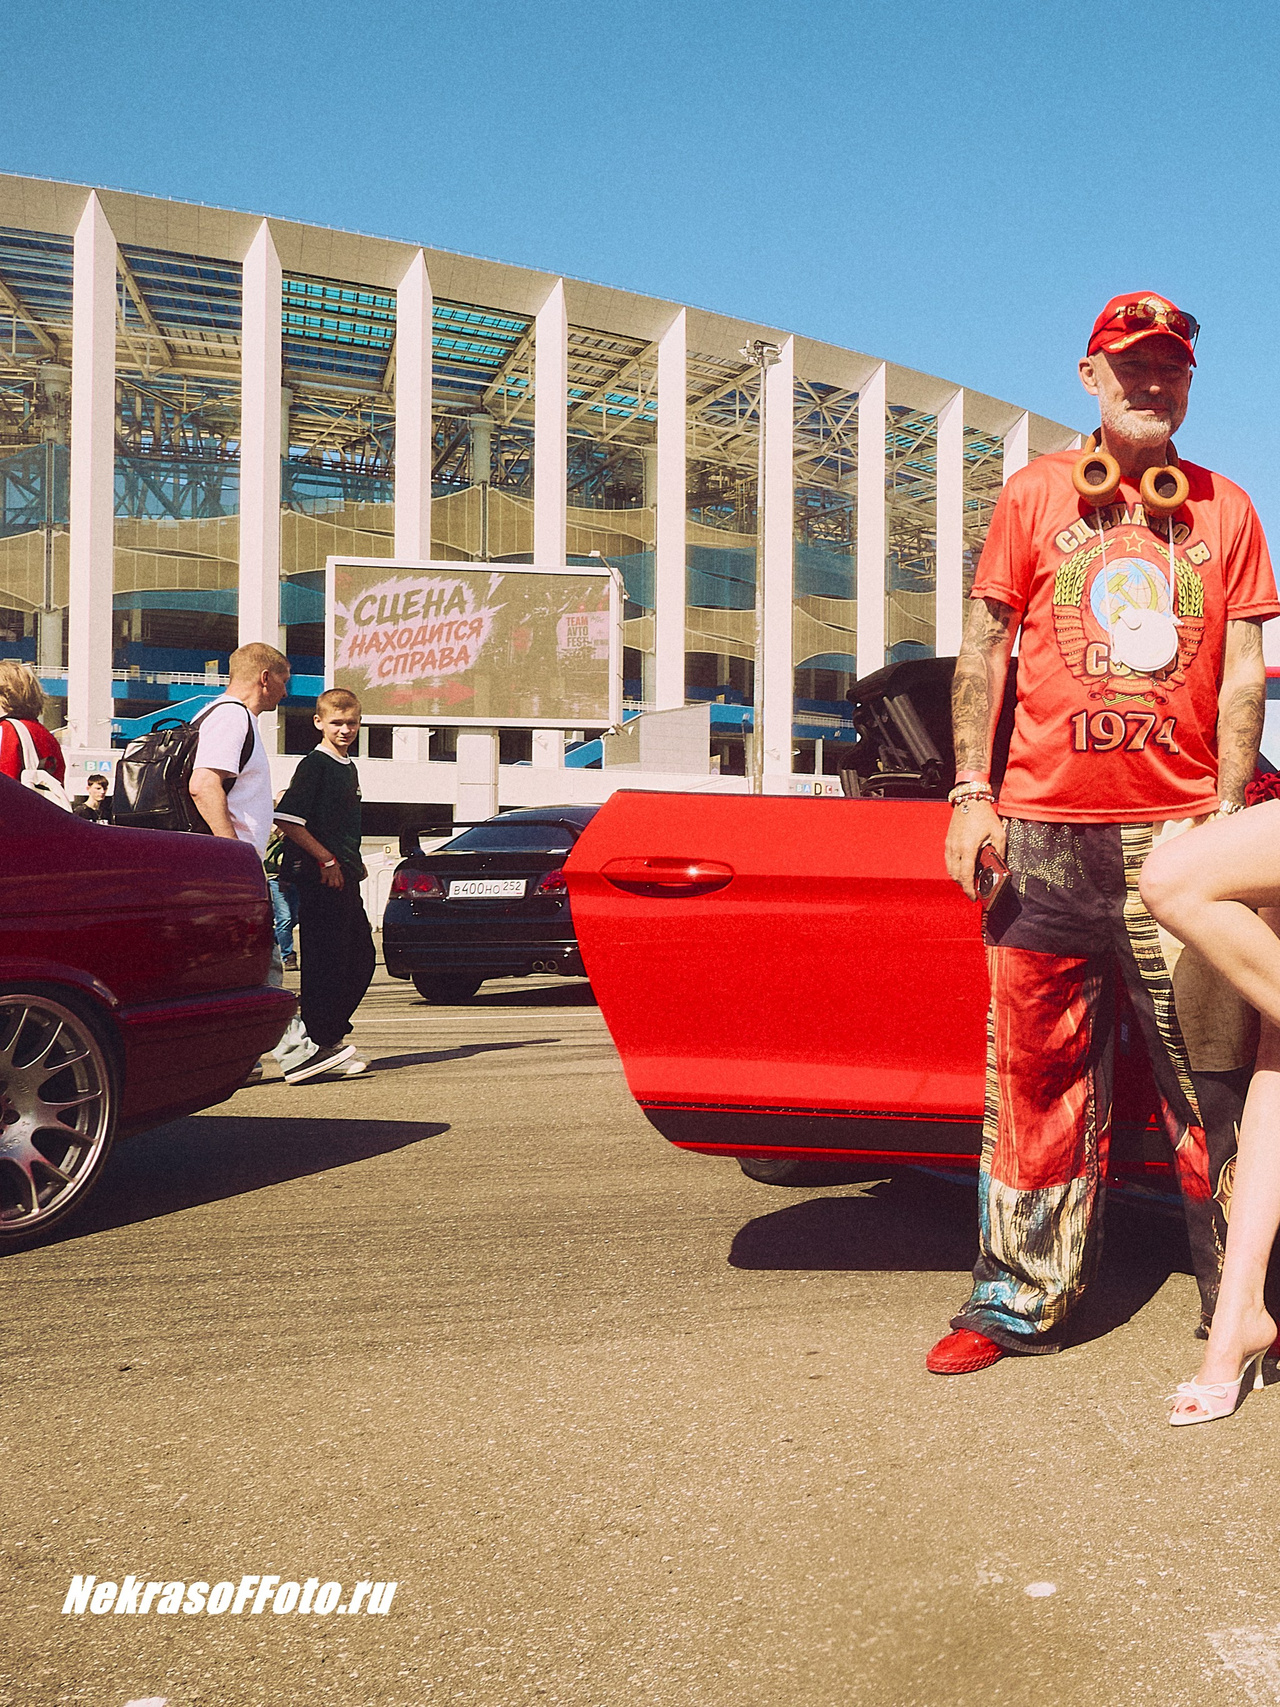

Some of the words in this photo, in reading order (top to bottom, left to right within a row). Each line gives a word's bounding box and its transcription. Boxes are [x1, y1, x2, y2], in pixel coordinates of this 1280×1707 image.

[353, 585, 467, 627] СЦЕНА
[566, 616, 589, 626] TEAM
[567, 626, 589, 636] AVTO
[348, 617, 484, 658] НАХОДИТСЯ
[377, 645, 471, 678] СПРАВА
[1072, 711, 1180, 754] 1974
[86, 761, 96, 771] B
[100, 761, 110, 771] A
[814, 783, 822, 795] D
[503, 881, 521, 891] 252
